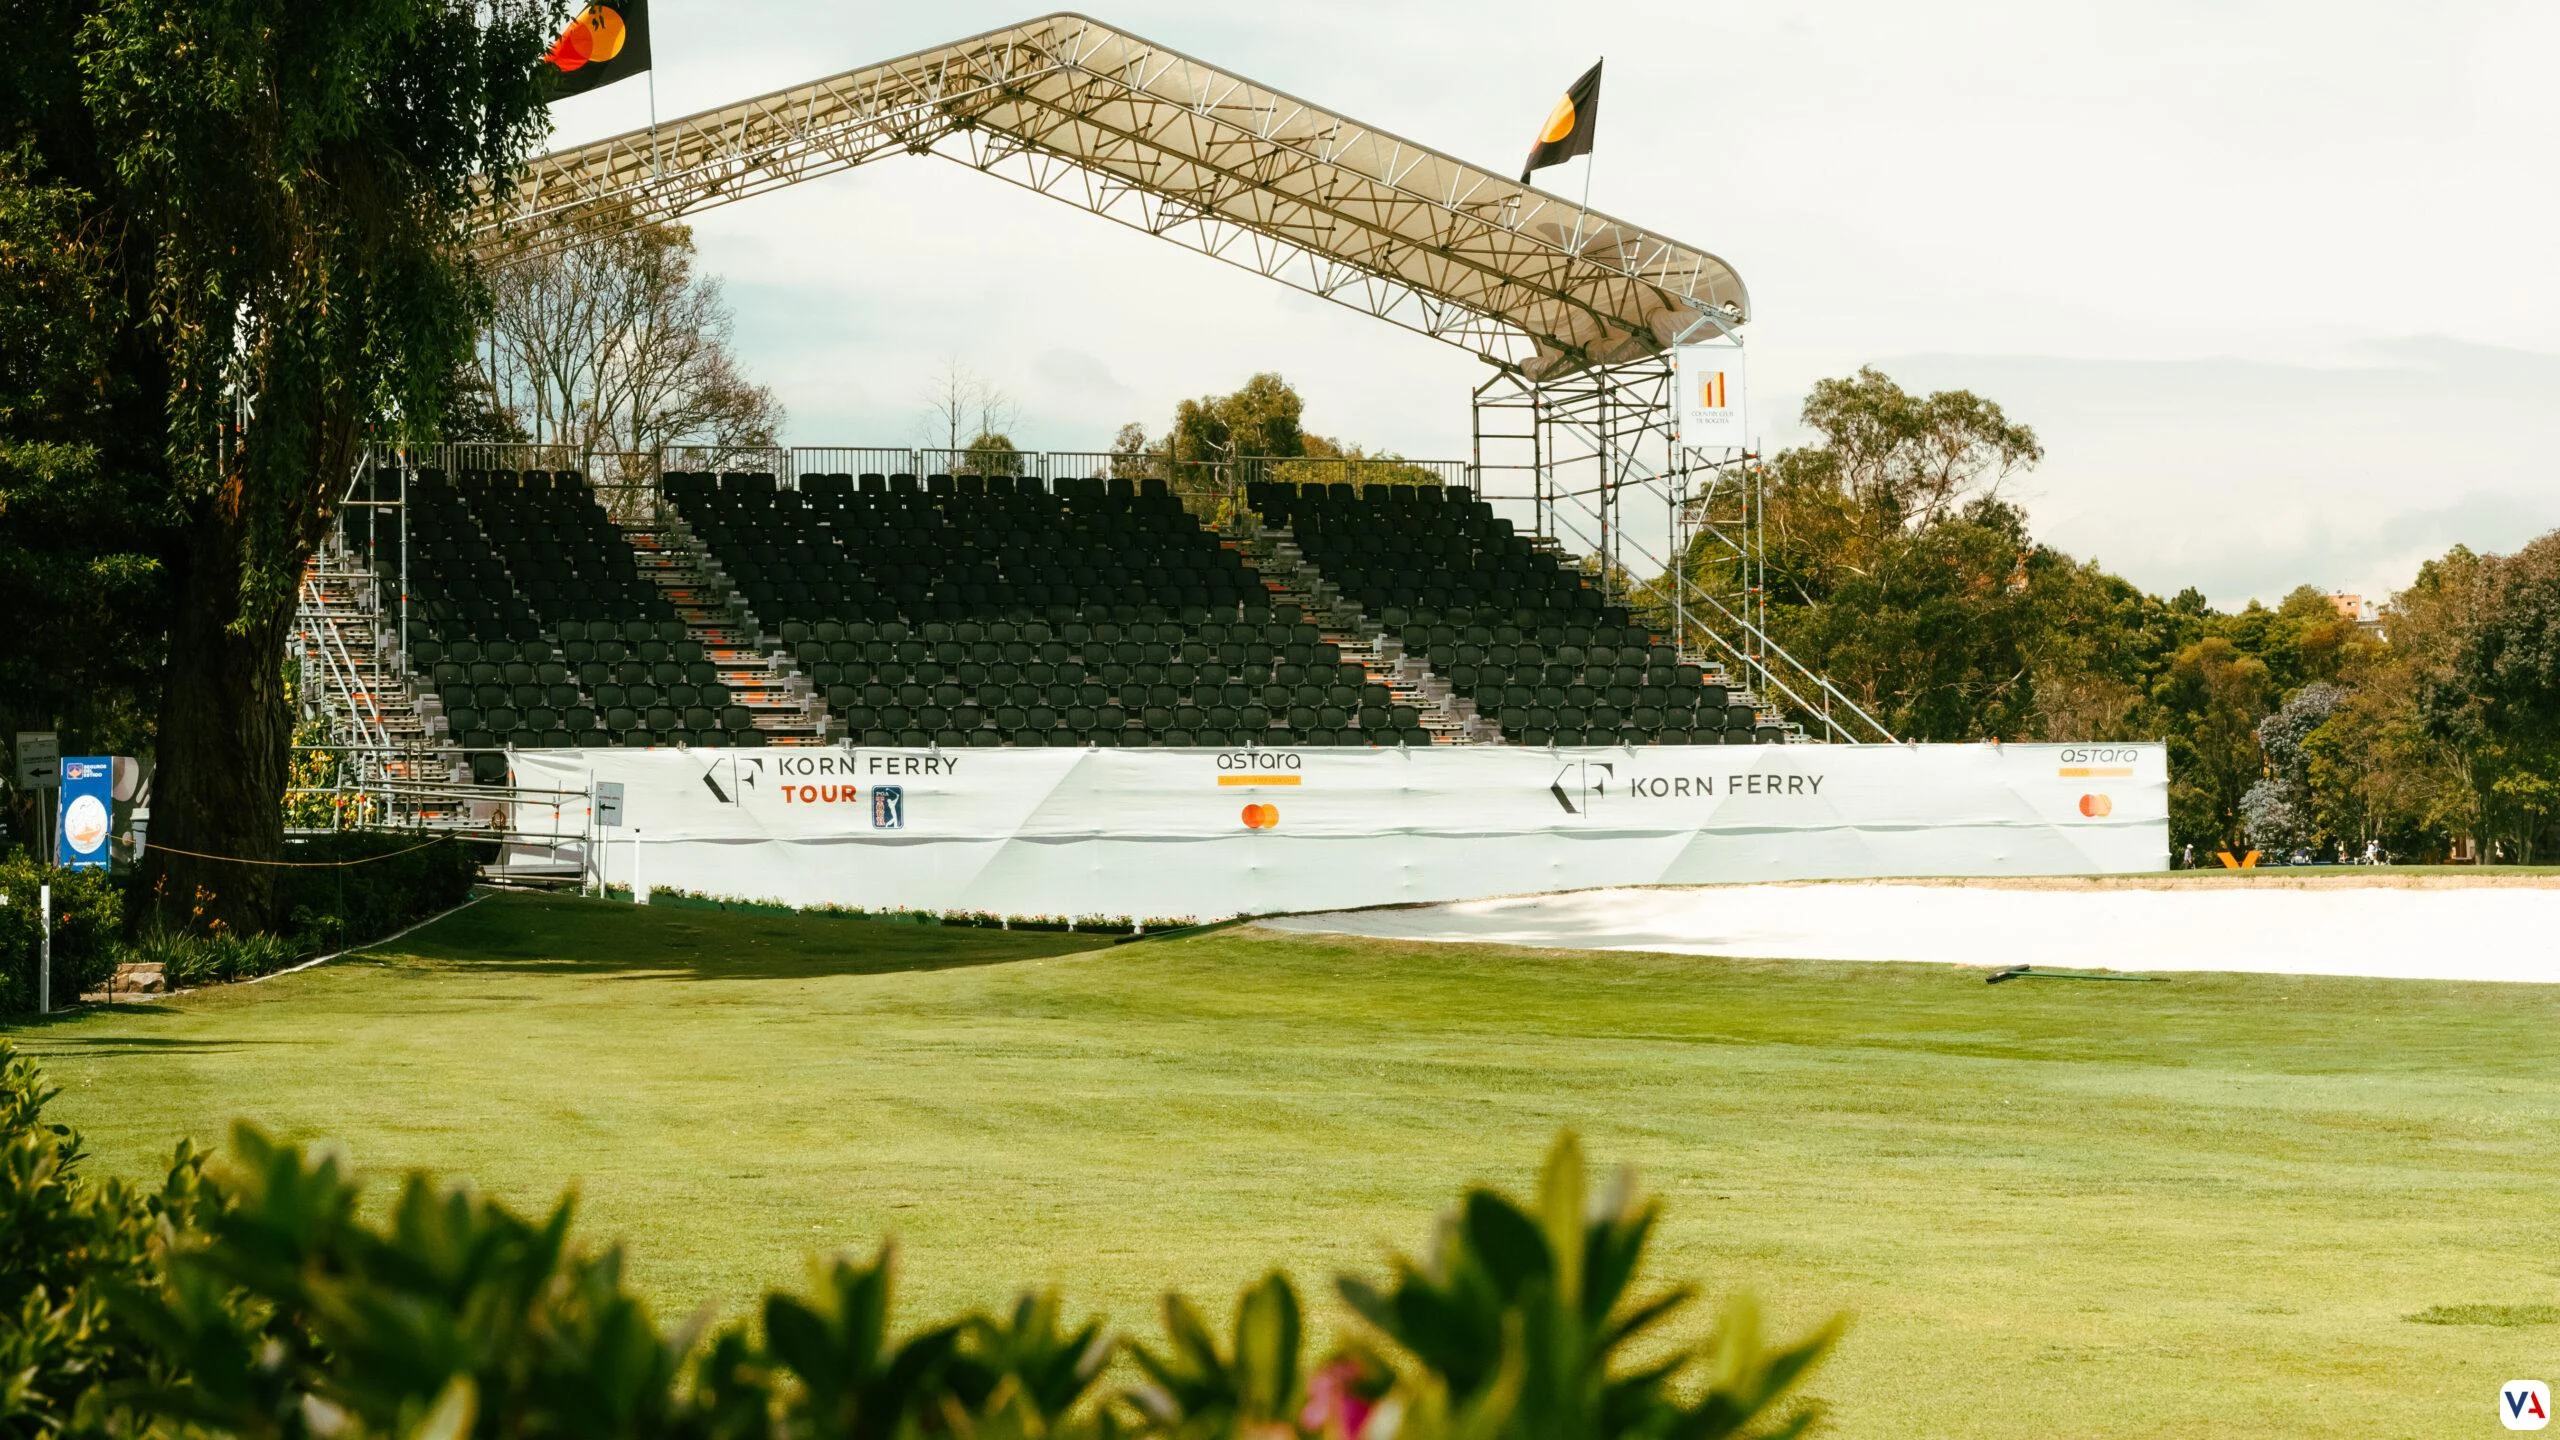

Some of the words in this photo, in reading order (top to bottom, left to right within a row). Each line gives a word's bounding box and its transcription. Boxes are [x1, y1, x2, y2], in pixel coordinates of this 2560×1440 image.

[779, 757, 855, 775] KORN
[870, 757, 959, 775] FERRY
[781, 785, 857, 804] TOUR
[1631, 777, 1713, 798] KORN
[1729, 775, 1824, 795] FERRY
